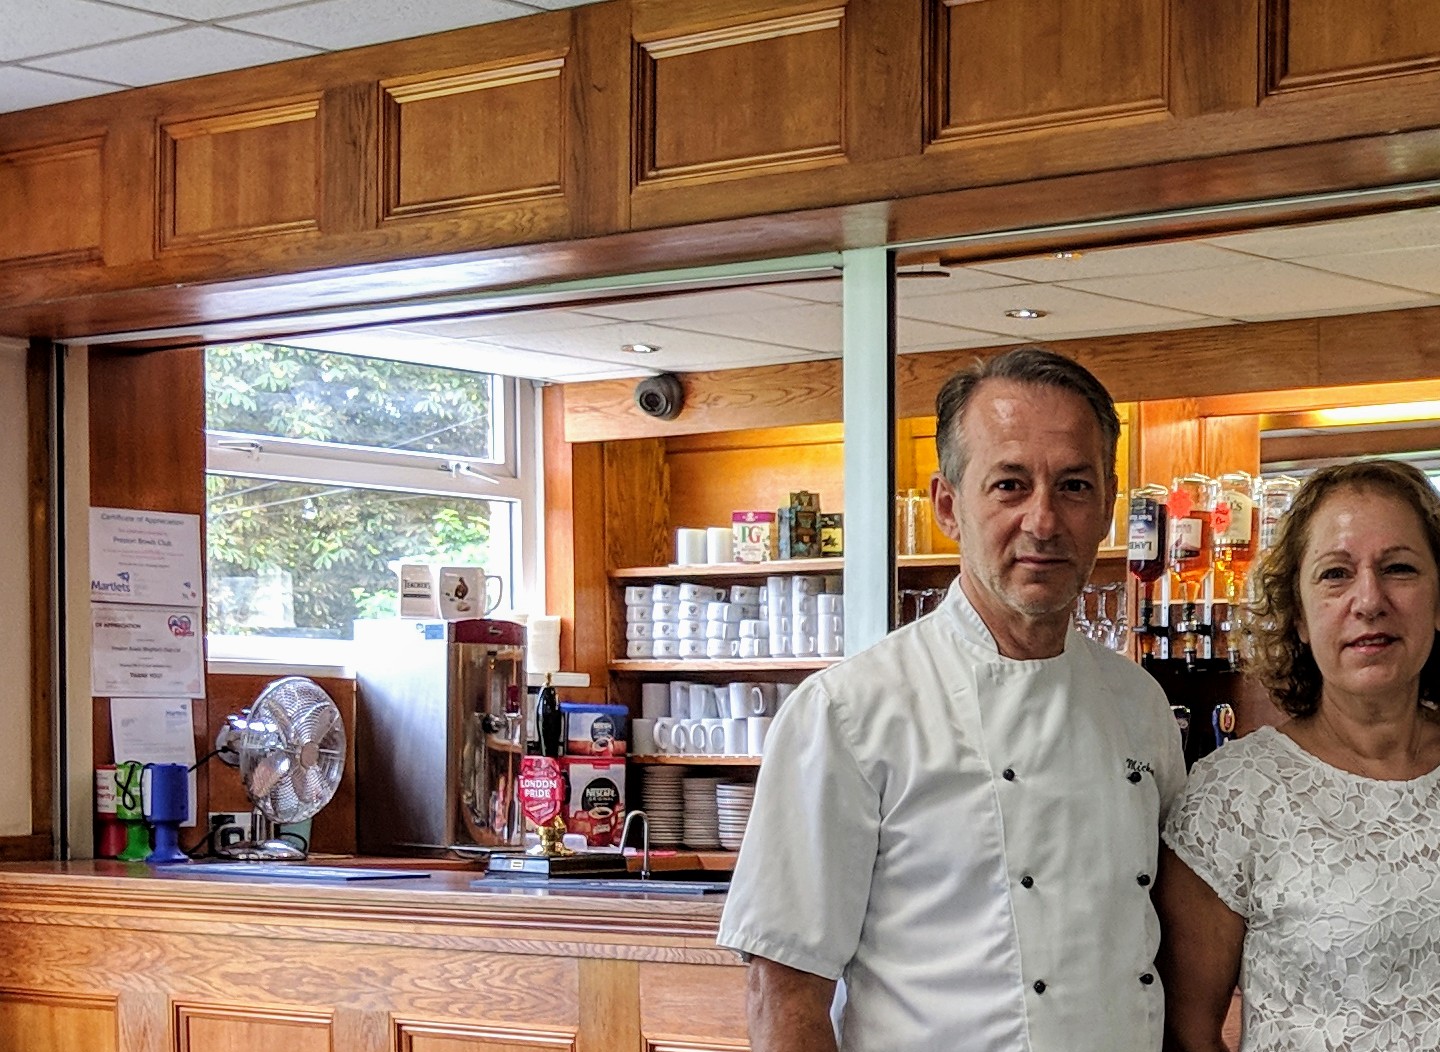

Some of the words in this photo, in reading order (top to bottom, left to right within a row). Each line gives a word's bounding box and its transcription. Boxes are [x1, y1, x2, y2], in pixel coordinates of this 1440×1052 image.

[741, 526, 761, 544] PG
[91, 580, 131, 593] Martlets
[520, 779, 557, 789] LONDON
[524, 788, 551, 798] PRIDE
